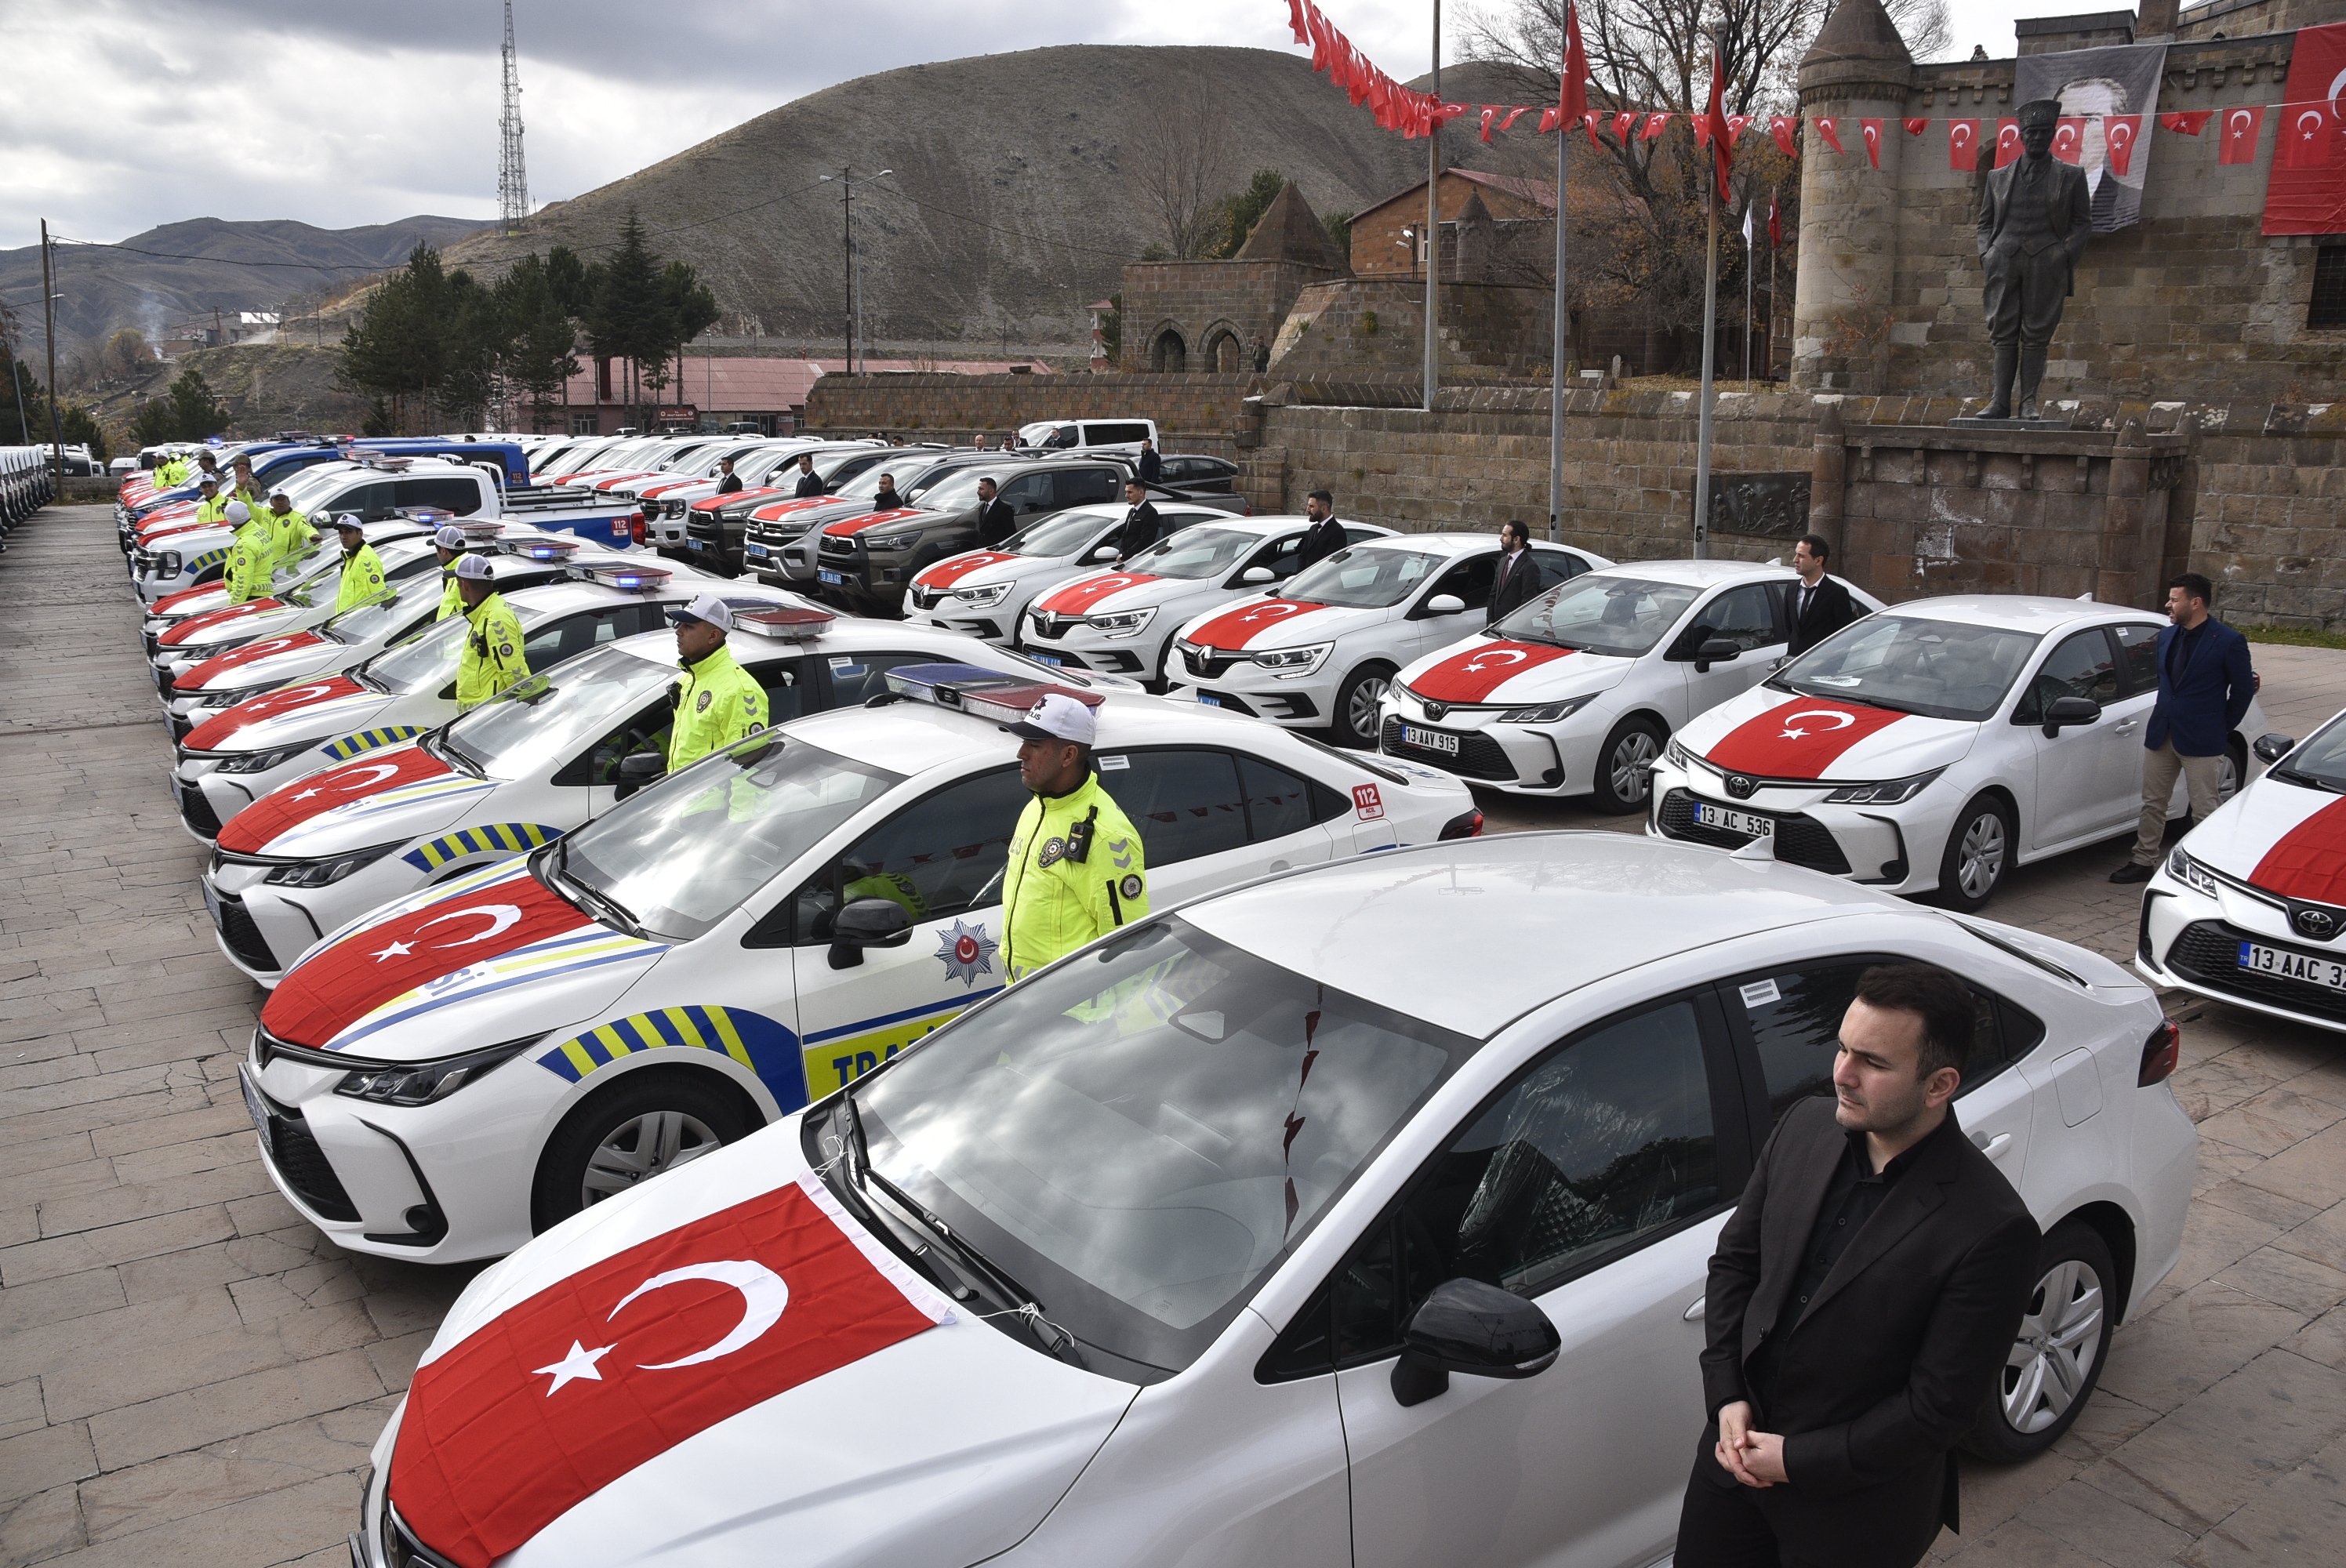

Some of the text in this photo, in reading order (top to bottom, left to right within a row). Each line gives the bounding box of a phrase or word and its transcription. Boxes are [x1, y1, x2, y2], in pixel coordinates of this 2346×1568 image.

[614, 520, 626, 529] 112
[1407, 728, 1456, 751] 13 AAV 915
[1356, 787, 1378, 806] 112
[1701, 806, 1715, 823] 13
[1723, 811, 1738, 829] AC
[1746, 816, 1770, 837] 536
[2252, 947, 2275, 970] 13
[2281, 954, 2321, 981] AAC
